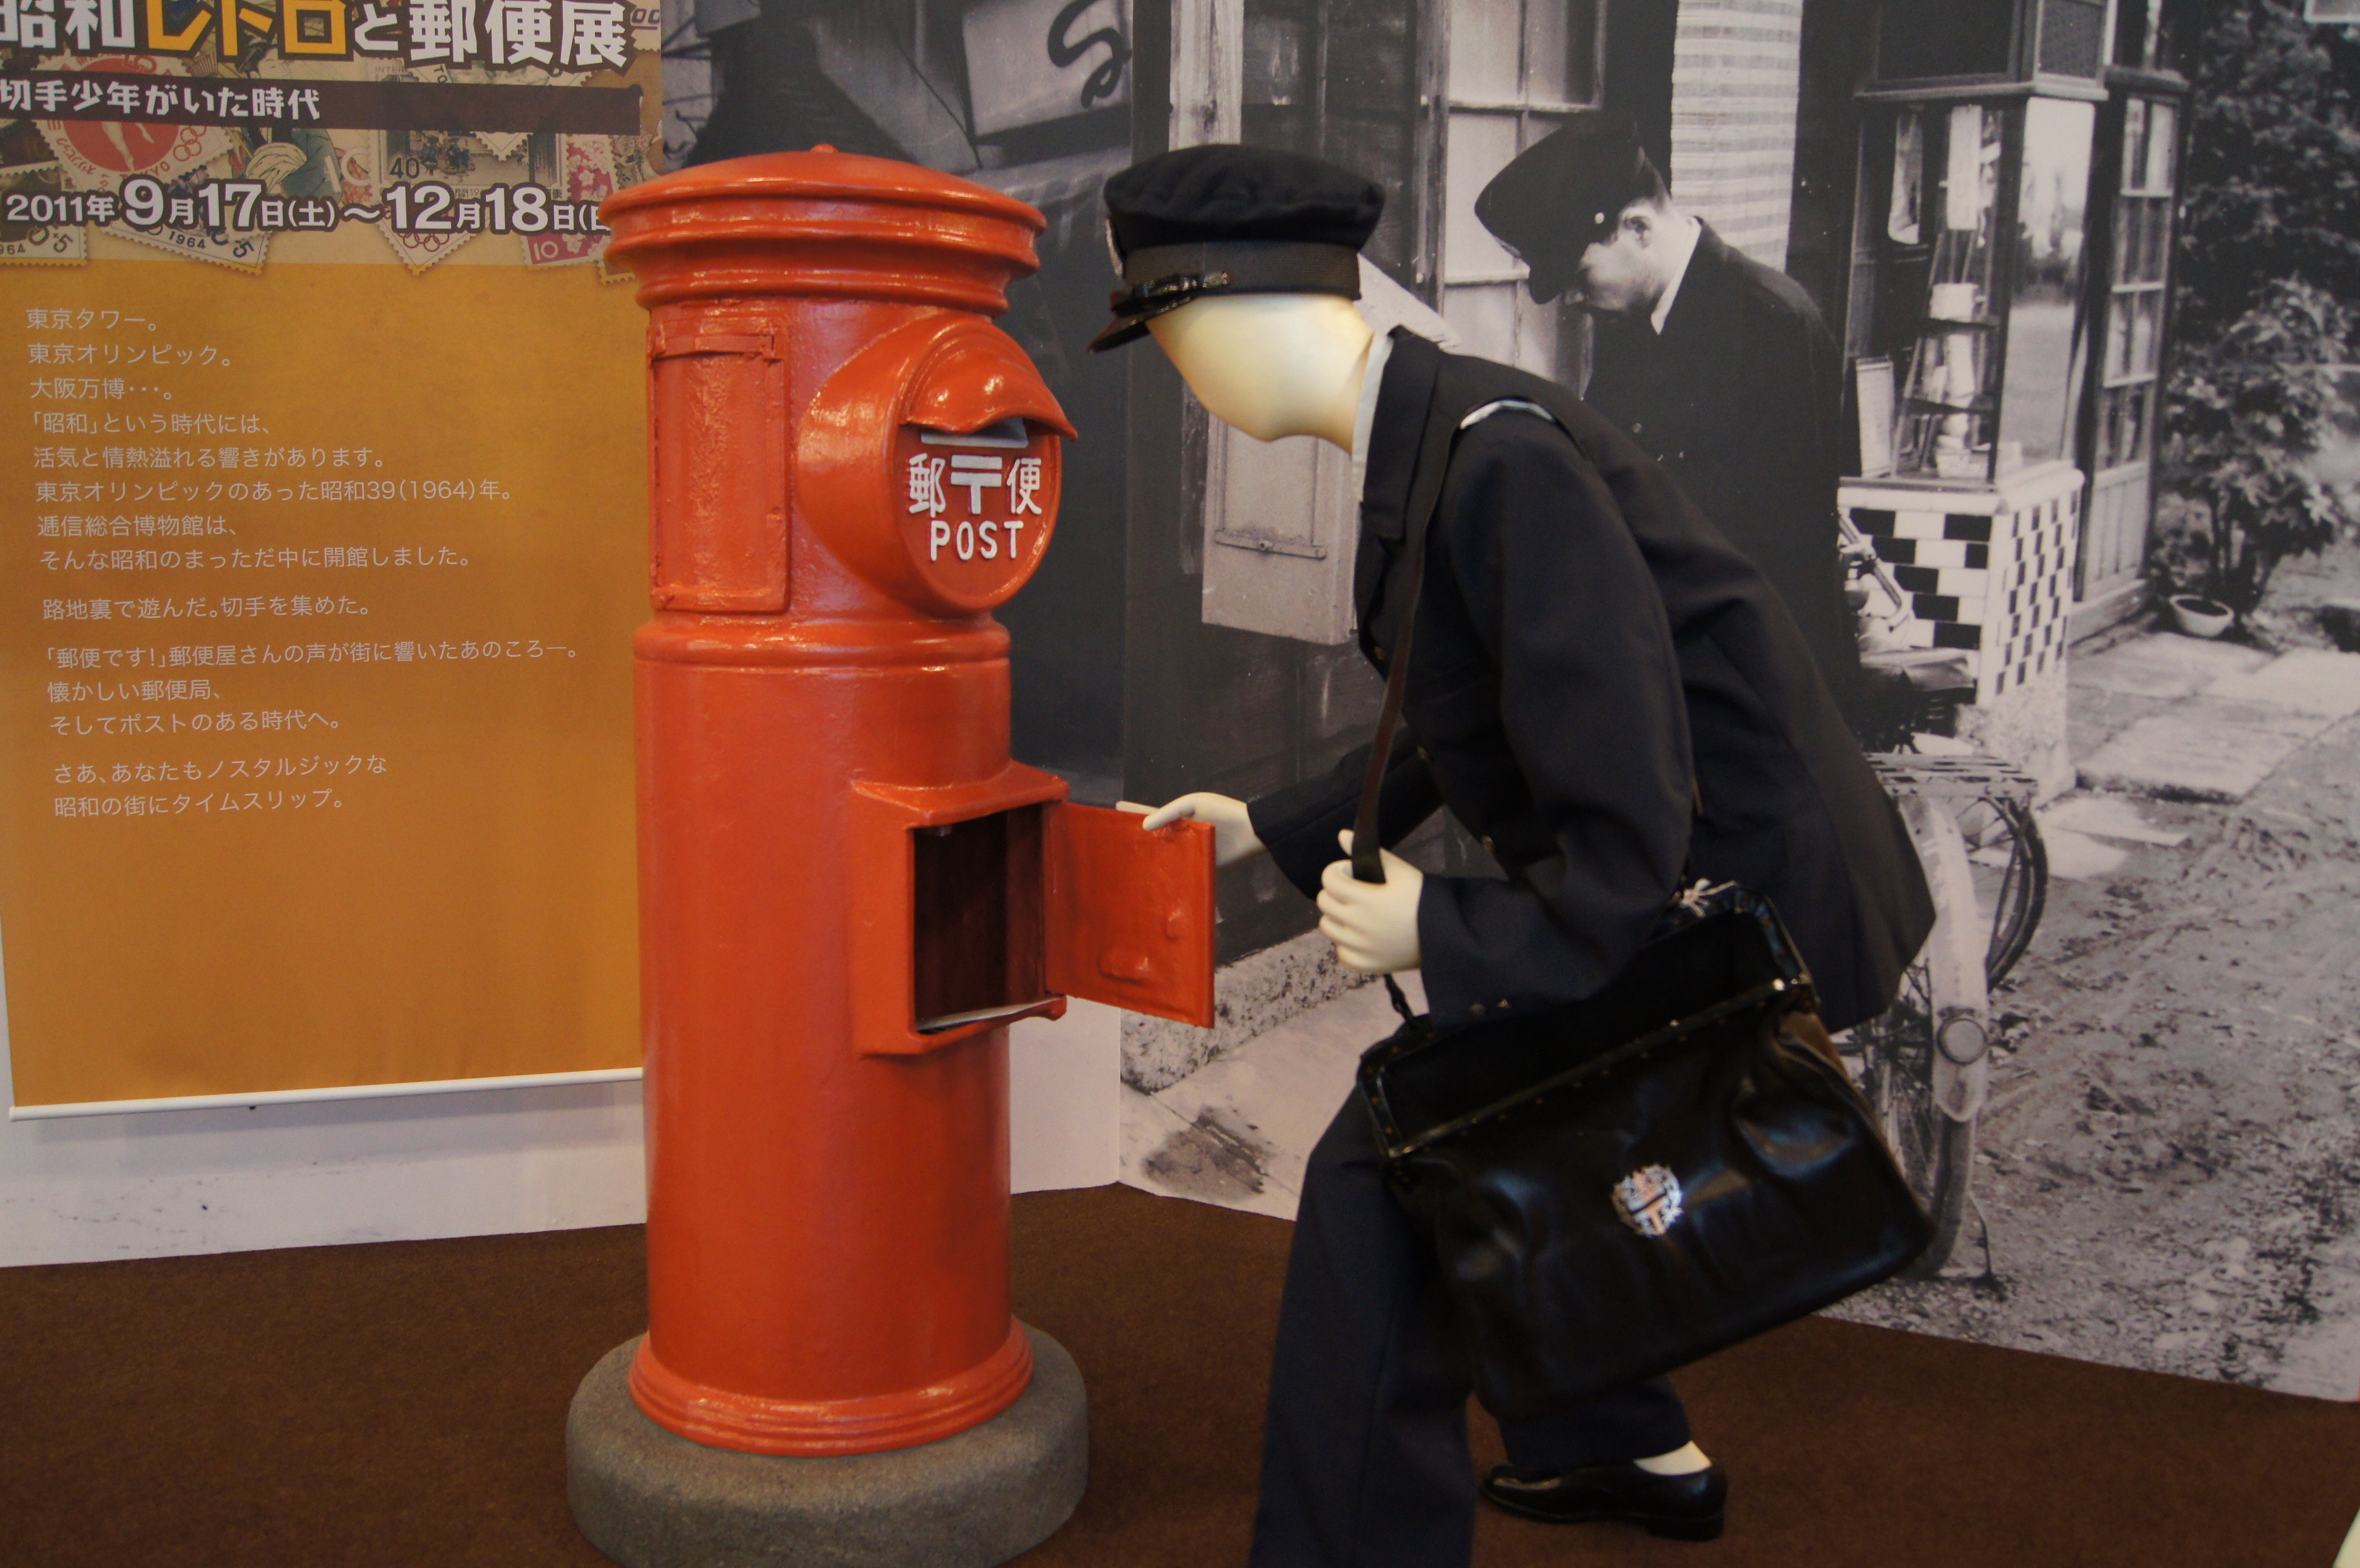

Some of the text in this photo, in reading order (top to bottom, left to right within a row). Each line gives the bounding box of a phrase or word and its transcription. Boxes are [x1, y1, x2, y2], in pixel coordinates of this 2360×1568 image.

[0, 80, 320, 120] 切手少年がいた時代
[389, 157, 420, 179] 40
[169, 231, 206, 249] 1964
[533, 241, 559, 261] 10
[27, 308, 157, 331] 東京タワー。
[28, 343, 231, 367] 東京オリンピック。
[34, 411, 269, 434] 「昭和」という時代には、
[34, 446, 383, 468] 活気と情熱溢れる響きがあります。
[37, 515, 236, 537] 逓信総合博物館は、
[930, 520, 1024, 561] POST
[40, 546, 468, 570] そんな昭和のまっただ中に開館しました。
[43, 595, 369, 620] 路地裏で遊んだ。切手を集めた。
[47, 679, 220, 703] 懐かしい郵便局、
[50, 710, 339, 735] そしてポストのある時代へ。
[55, 755, 387, 784] さあ、あなたもノスタルジックな
[54, 788, 342, 817] 昭和の街にタイムスリップ。
